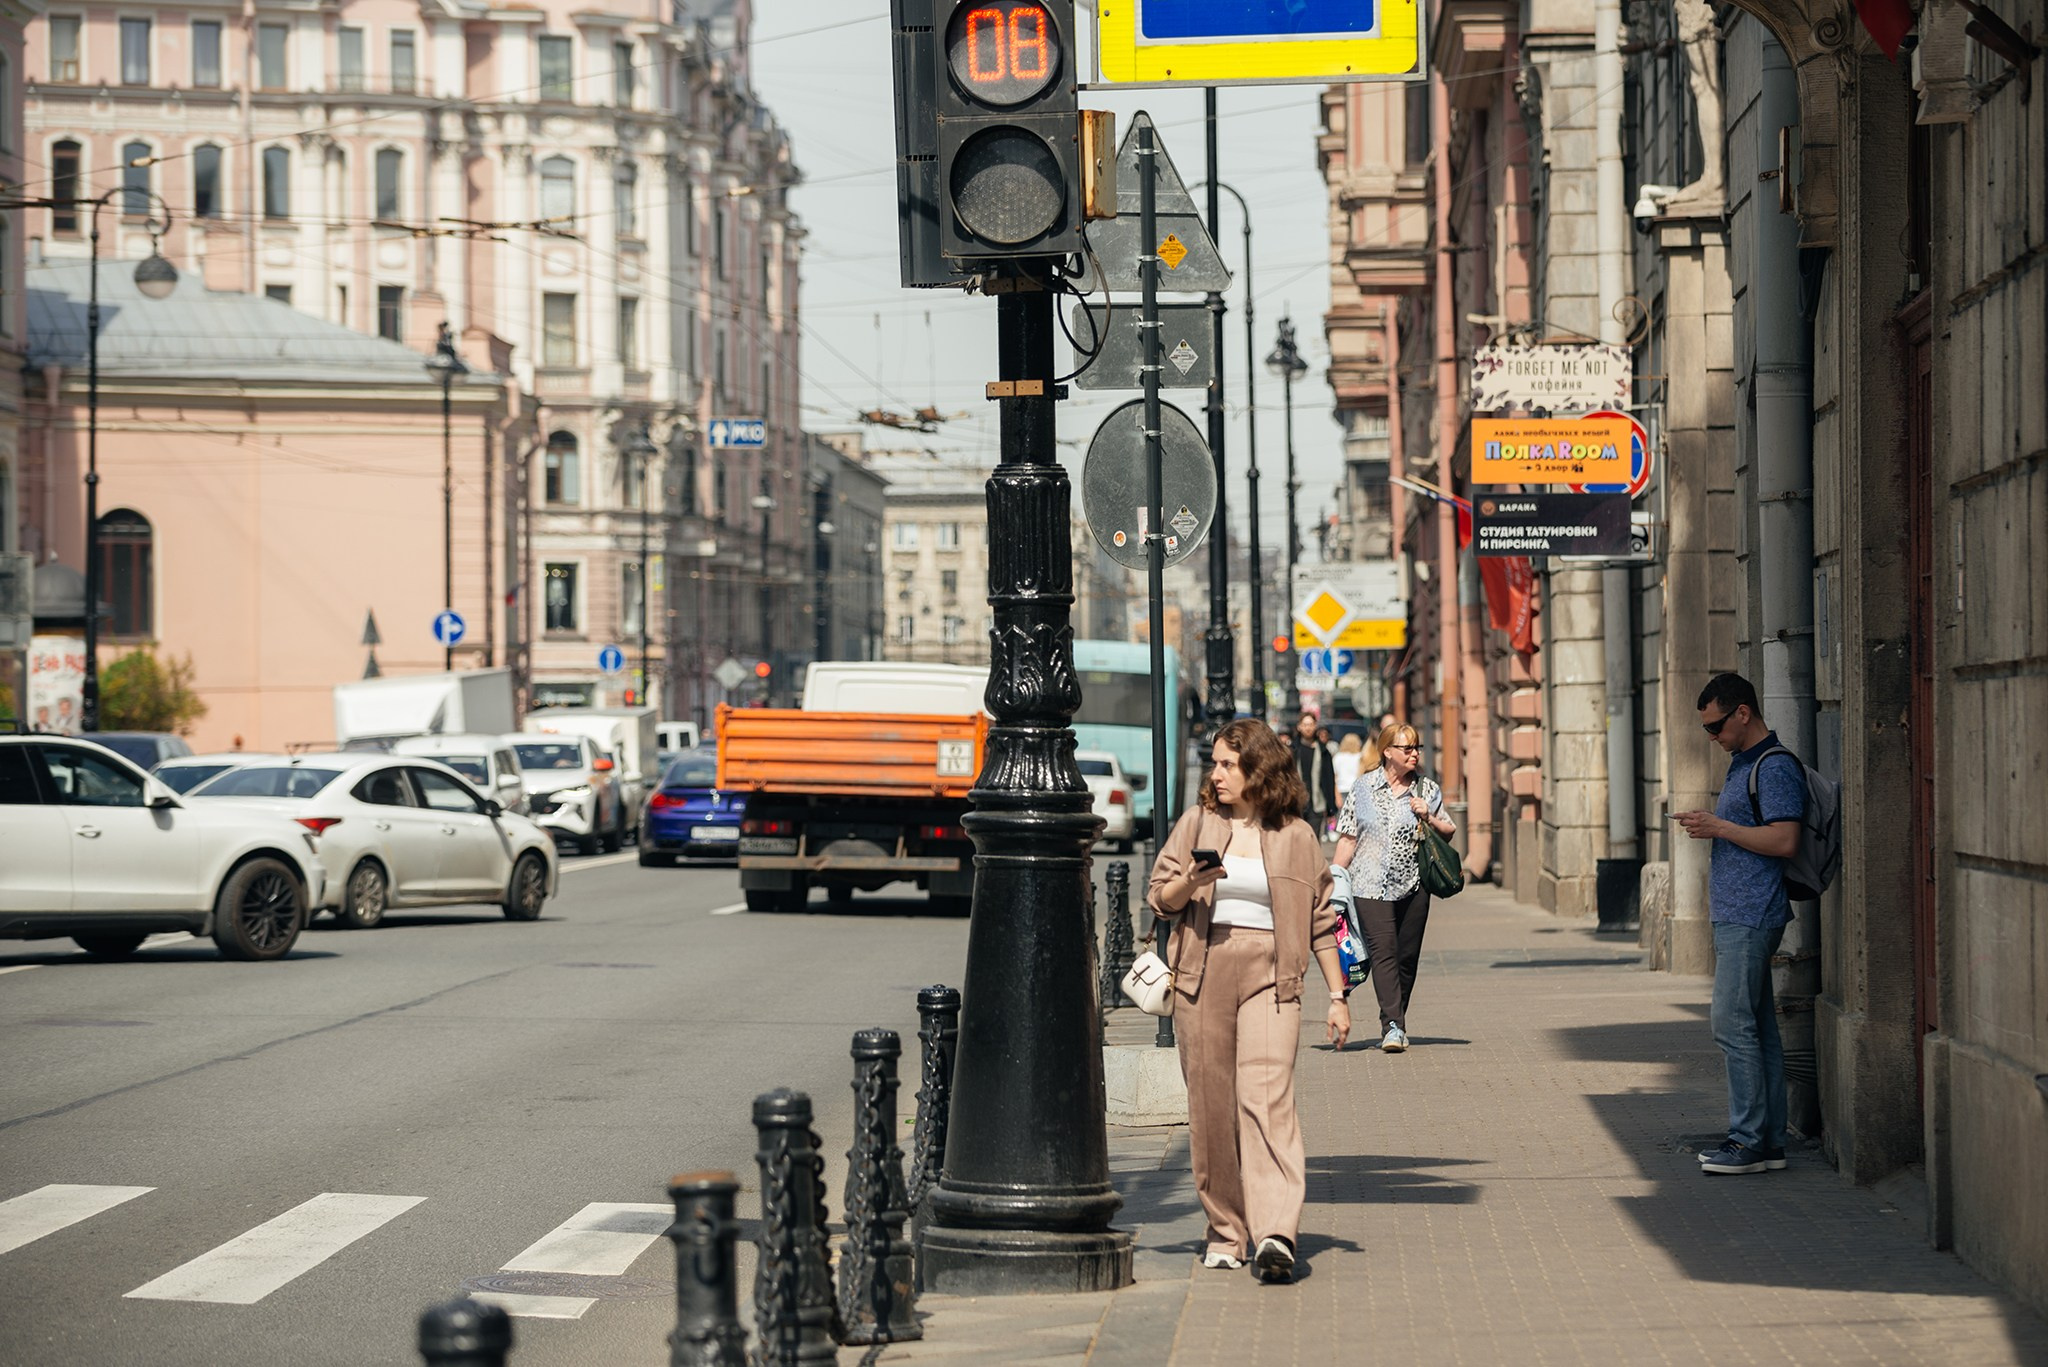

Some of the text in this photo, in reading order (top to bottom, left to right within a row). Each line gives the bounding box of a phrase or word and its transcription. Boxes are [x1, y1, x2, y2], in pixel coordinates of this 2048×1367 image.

[966, 7, 1048, 82] 08
[1507, 360, 1608, 376] FORGET ME NOT
[1530, 378, 1582, 395] кофейня
[1479, 526, 1598, 538] СТУДИЯ ТАТУИРОВКИ
[1479, 538, 1550, 550] И ПИРСИНГА
